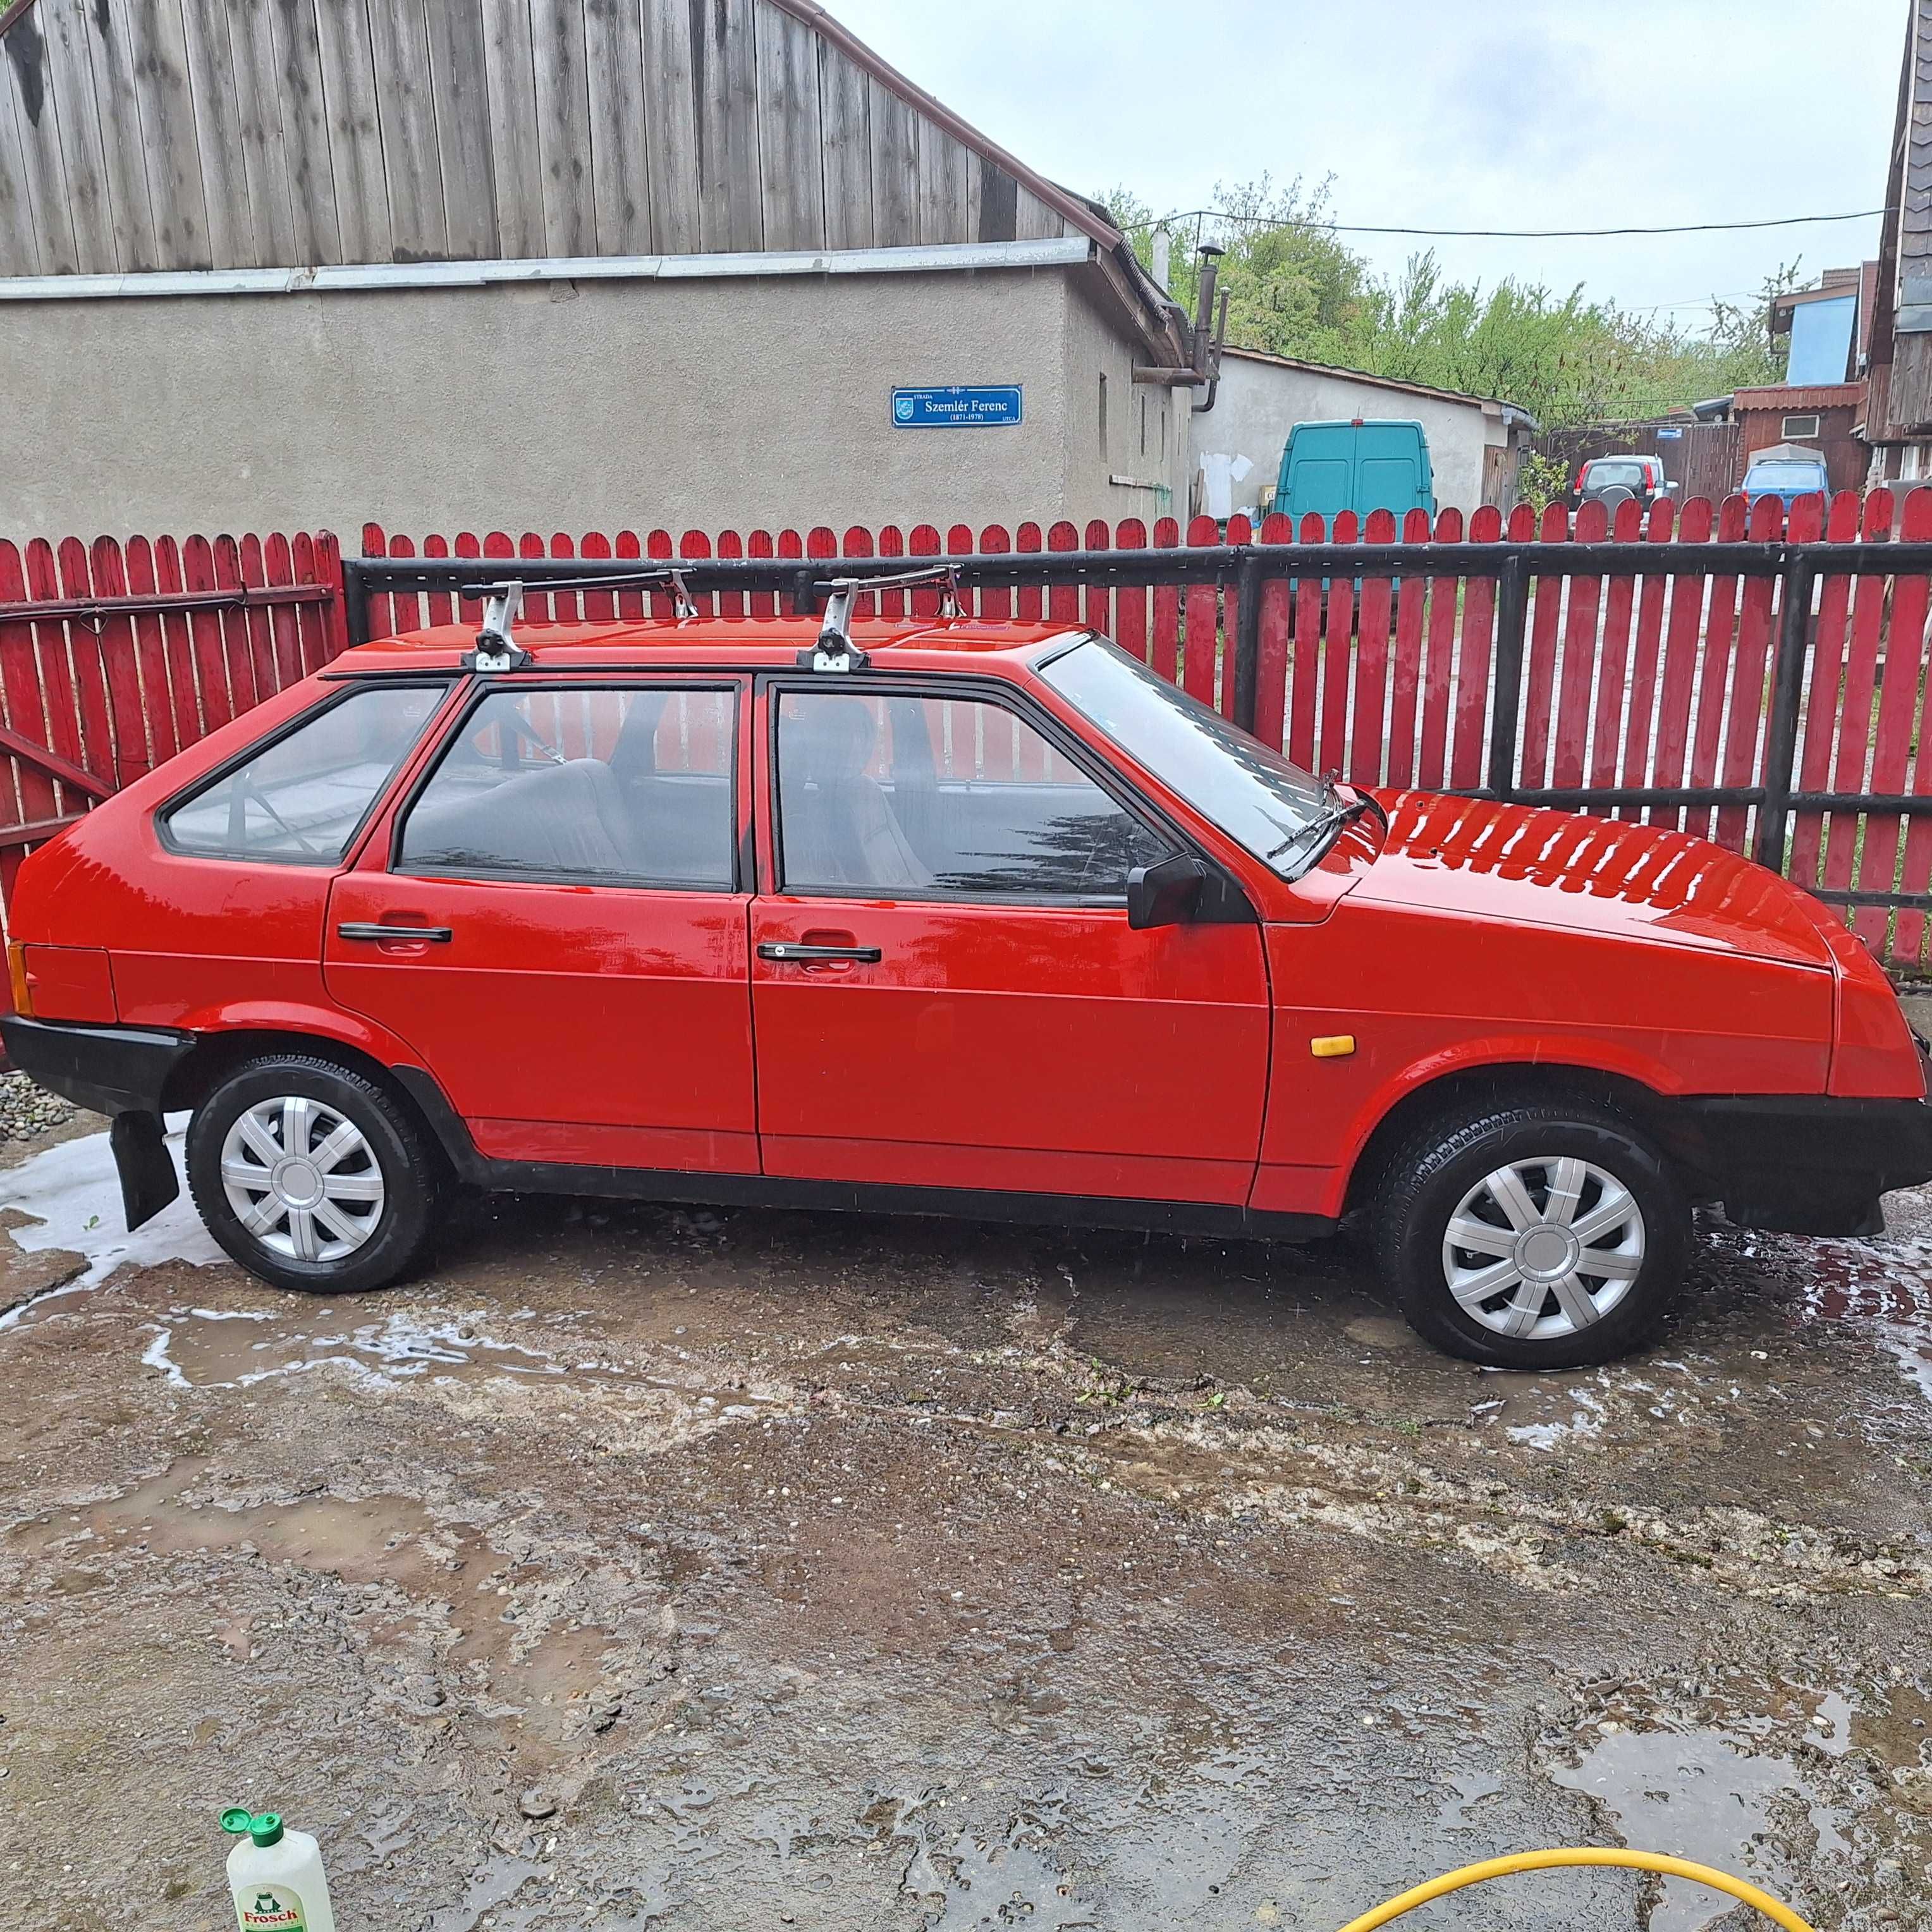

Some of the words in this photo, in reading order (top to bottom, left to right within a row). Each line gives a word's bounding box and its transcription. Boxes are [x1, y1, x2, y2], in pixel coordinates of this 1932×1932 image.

[925, 400, 969, 412] Szemlér
[971, 400, 1008, 412] Ferenc
[243, 1910, 298, 1923] Frosch
